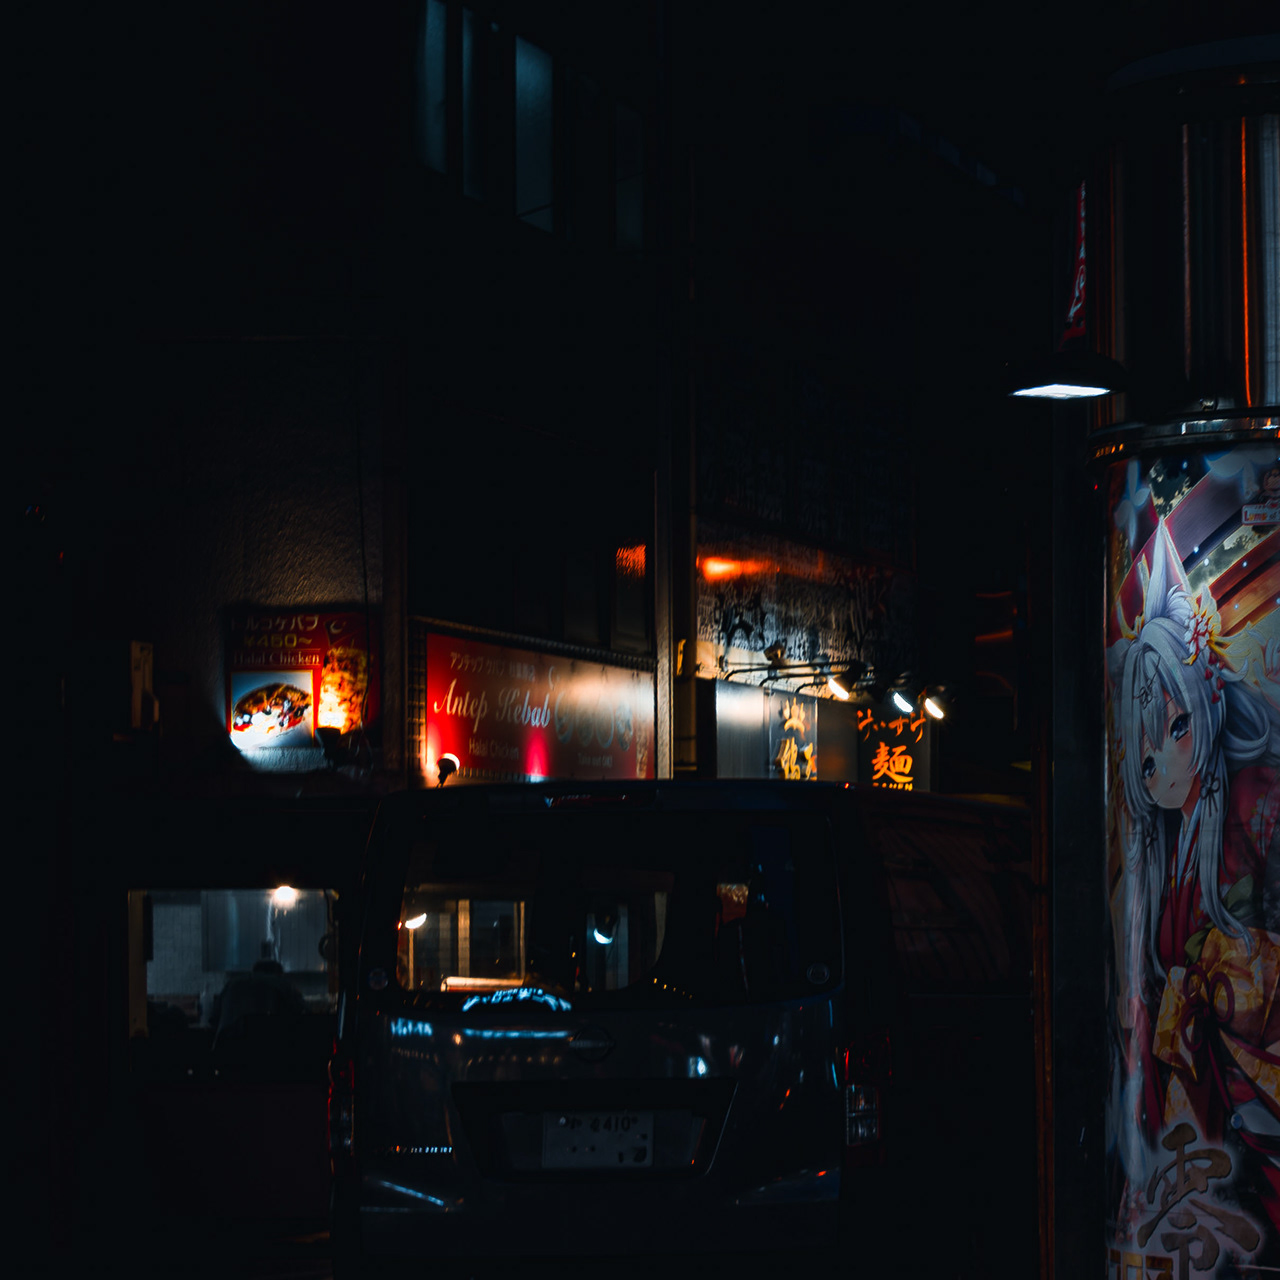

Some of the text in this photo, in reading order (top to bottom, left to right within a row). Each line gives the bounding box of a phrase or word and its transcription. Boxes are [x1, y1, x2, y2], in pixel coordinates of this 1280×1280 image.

[434, 678, 550, 734] Antep Kebab
[871, 741, 914, 783] 麺
